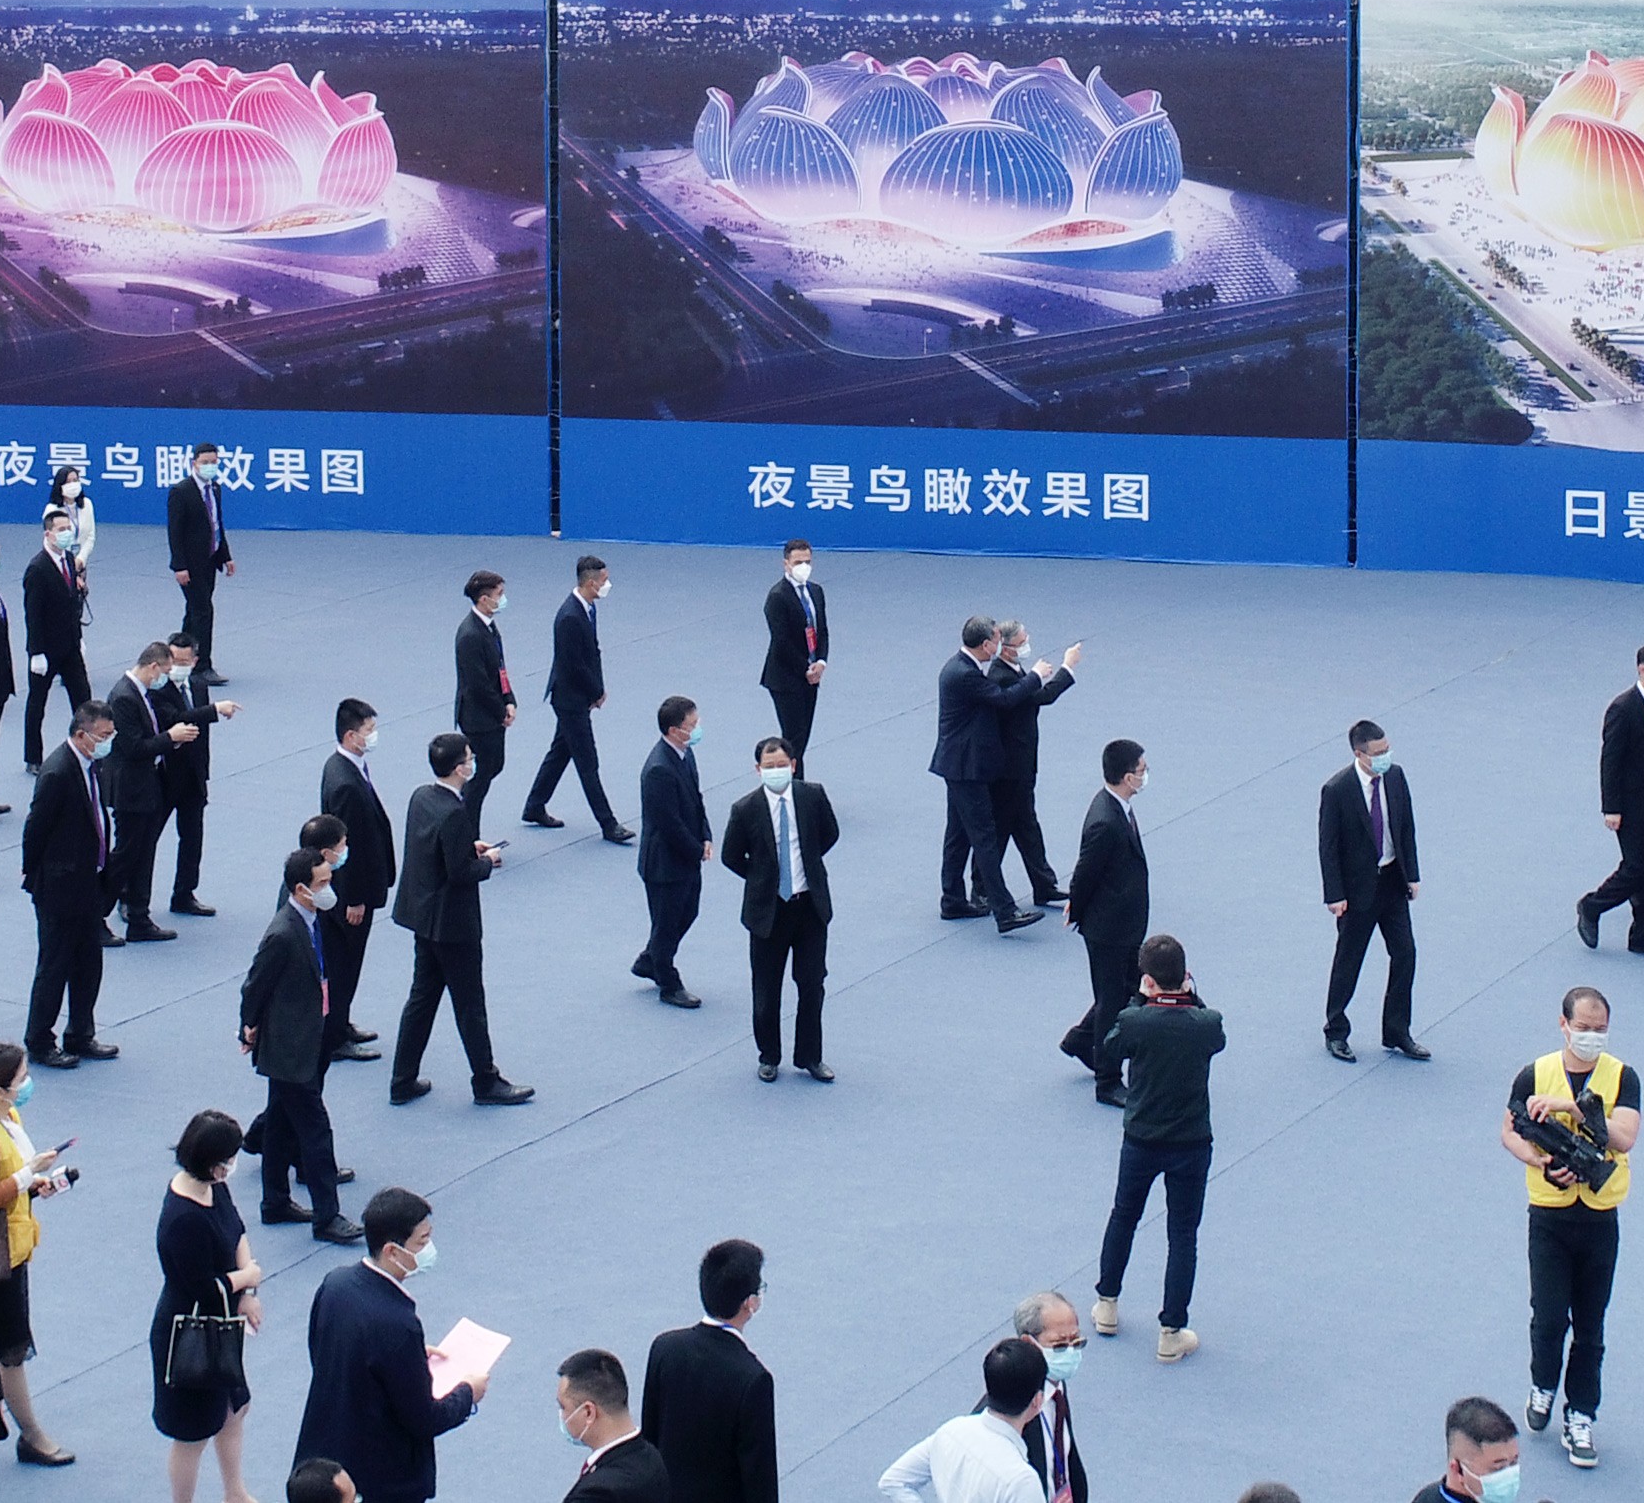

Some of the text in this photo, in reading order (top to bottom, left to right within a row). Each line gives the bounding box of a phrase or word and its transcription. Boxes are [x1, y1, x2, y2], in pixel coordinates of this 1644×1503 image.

[747, 461, 1150, 521] 夜景鸟瞰效果图
